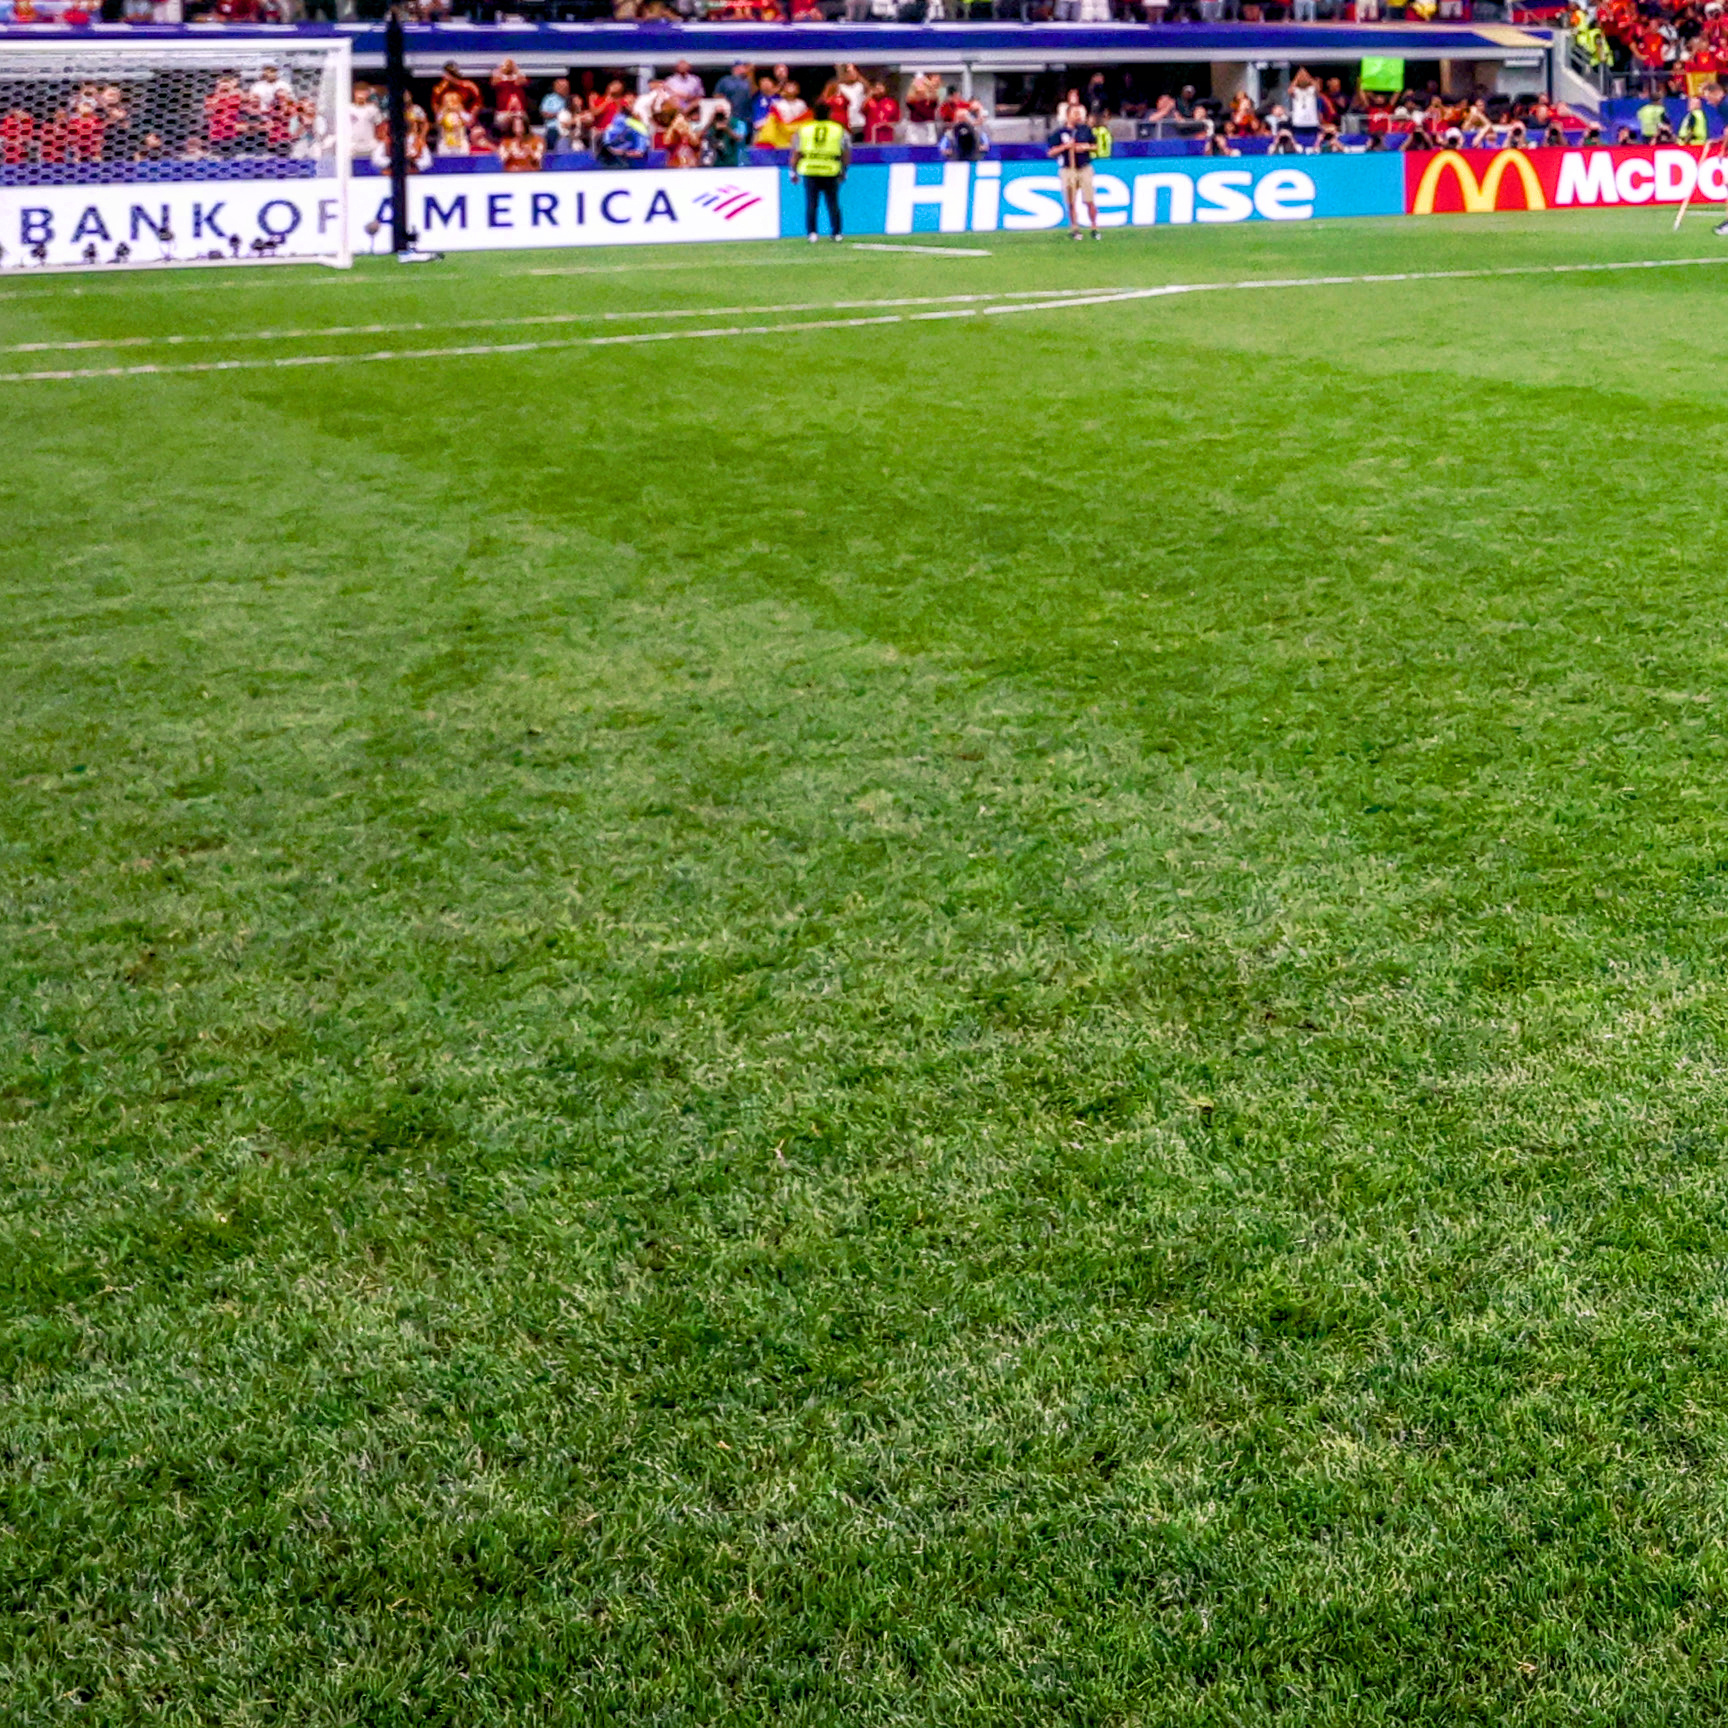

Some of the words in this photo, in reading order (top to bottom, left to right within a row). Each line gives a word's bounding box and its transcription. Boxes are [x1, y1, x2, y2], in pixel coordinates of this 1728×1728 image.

[20, 202, 227, 245] BANK
[257, 198, 340, 237] OF
[885, 160, 1317, 235] Hisense
